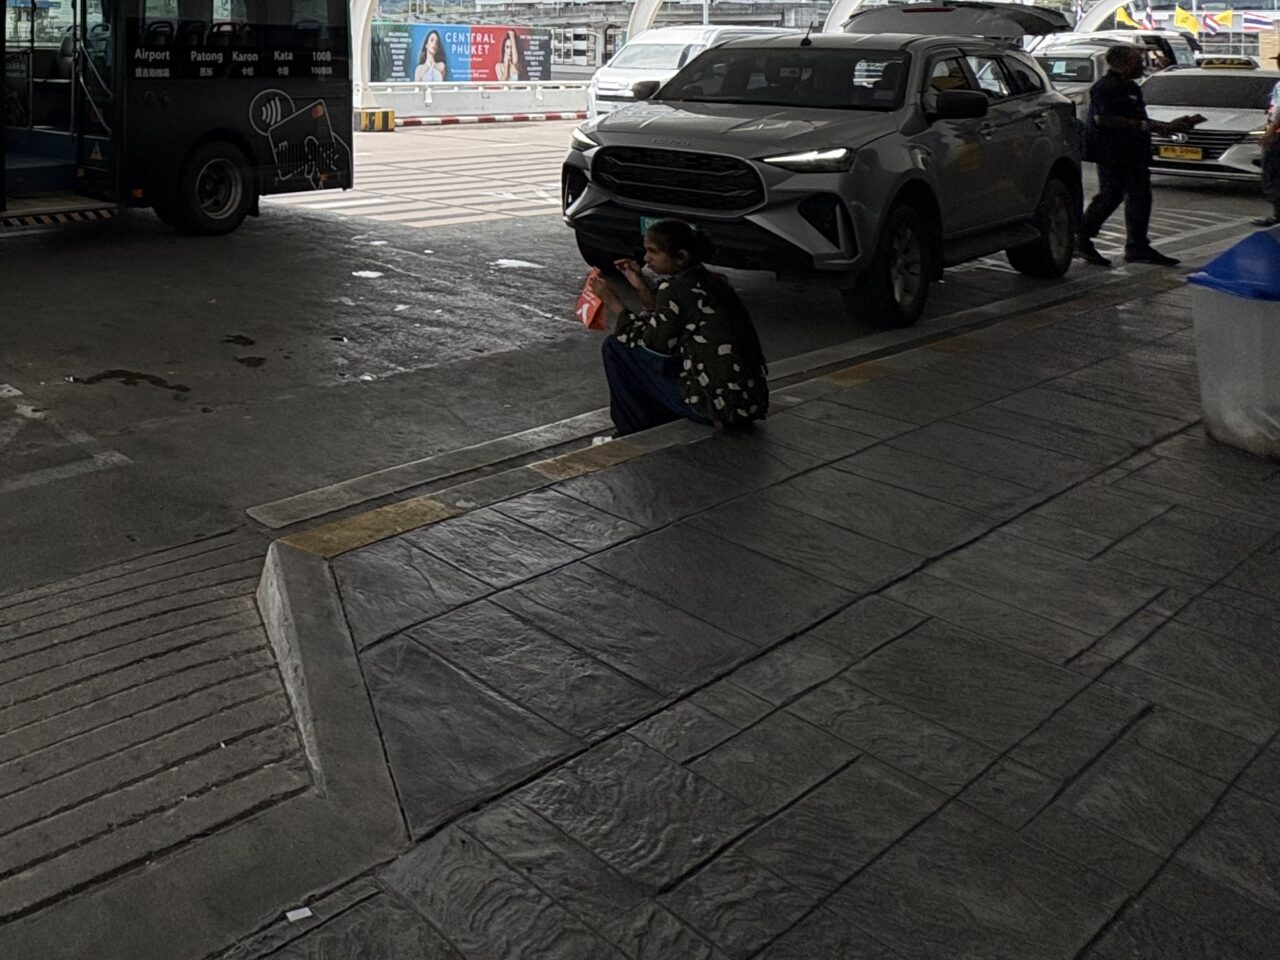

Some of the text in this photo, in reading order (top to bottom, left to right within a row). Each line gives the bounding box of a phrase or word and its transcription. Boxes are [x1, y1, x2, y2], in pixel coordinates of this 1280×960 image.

[445, 32, 496, 44] CENTRAL
[134, 47, 170, 62] Airport
[273, 49, 293, 61] Kata
[451, 43, 490, 55] PHUKET
[190, 50, 223, 64] Patong
[232, 50, 259, 62] Karon
